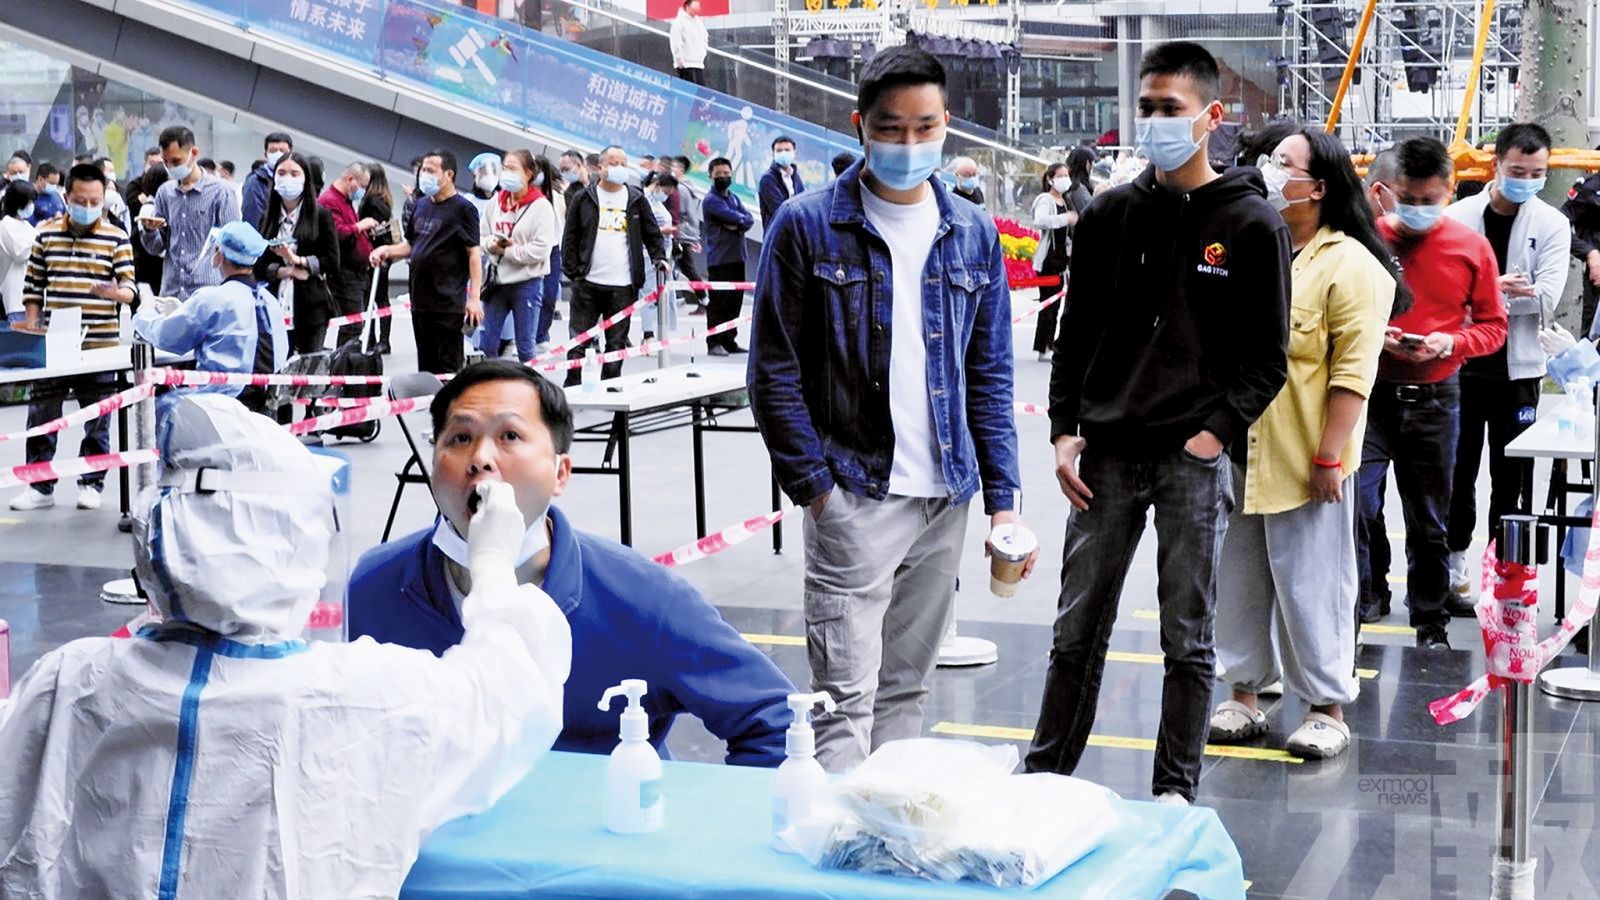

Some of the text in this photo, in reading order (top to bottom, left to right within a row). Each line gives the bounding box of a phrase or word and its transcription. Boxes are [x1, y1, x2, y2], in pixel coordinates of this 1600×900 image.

[289, 0, 367, 40] 情系未来
[587, 72, 668, 117] 和谐城市
[580, 97, 660, 143] 法治护航
